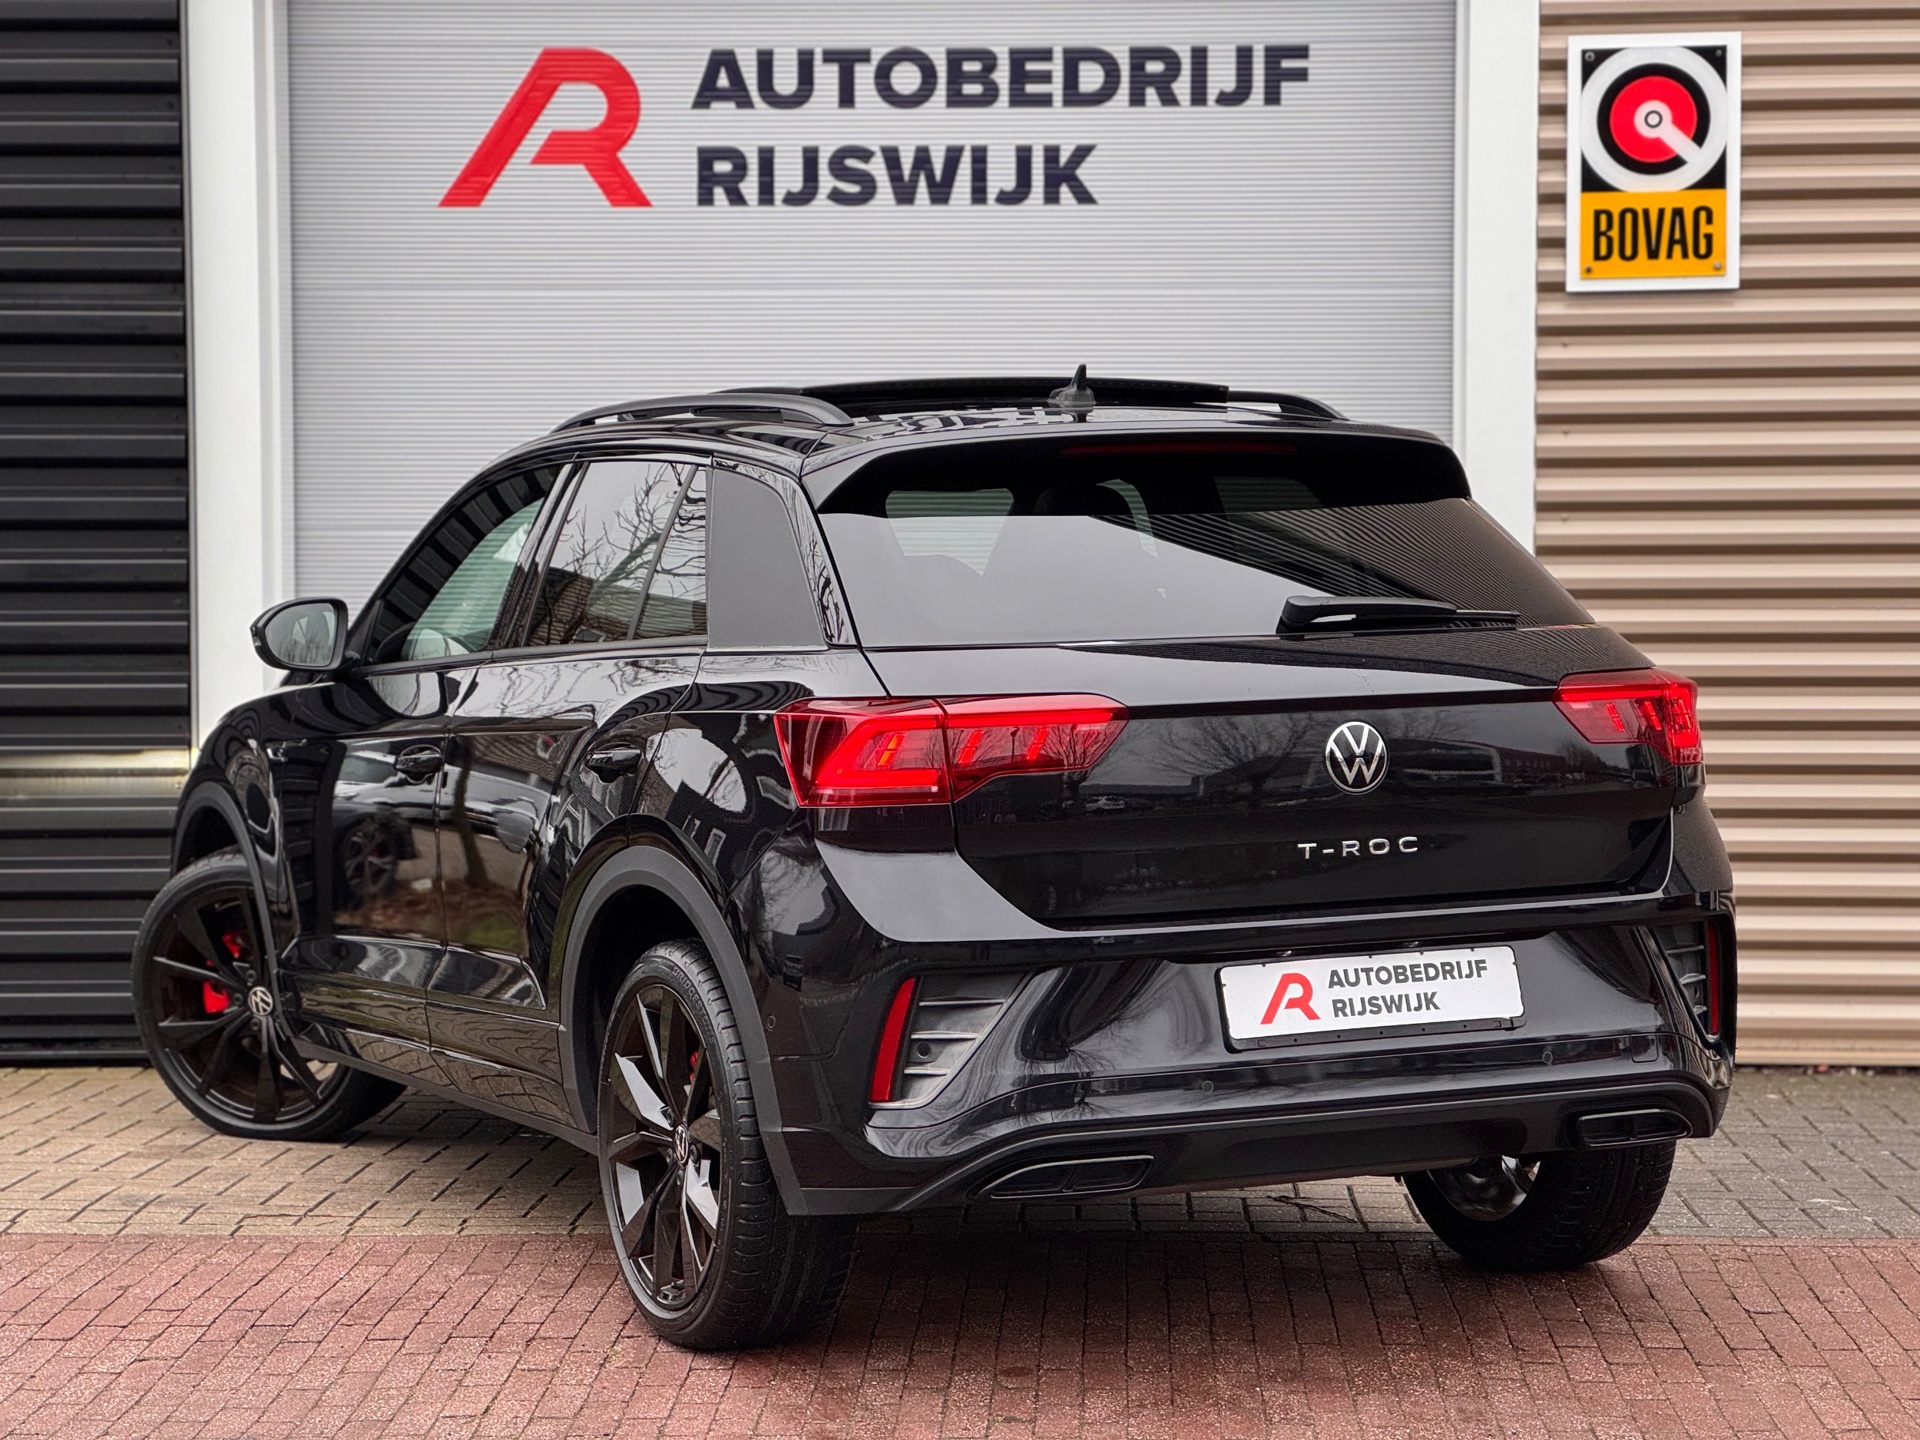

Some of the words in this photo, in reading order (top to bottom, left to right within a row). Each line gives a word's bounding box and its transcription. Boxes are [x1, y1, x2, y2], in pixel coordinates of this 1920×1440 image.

[691, 44, 1310, 110] AUTOBEDRIJF
[697, 144, 1098, 207] RIJSWIJK
[1593, 205, 1714, 262] BOVAG
[1297, 836, 1418, 860] T-ROC
[1328, 958, 1488, 989] AUTOBEDRIJF
[1331, 991, 1441, 1018] RIJSWIJK
